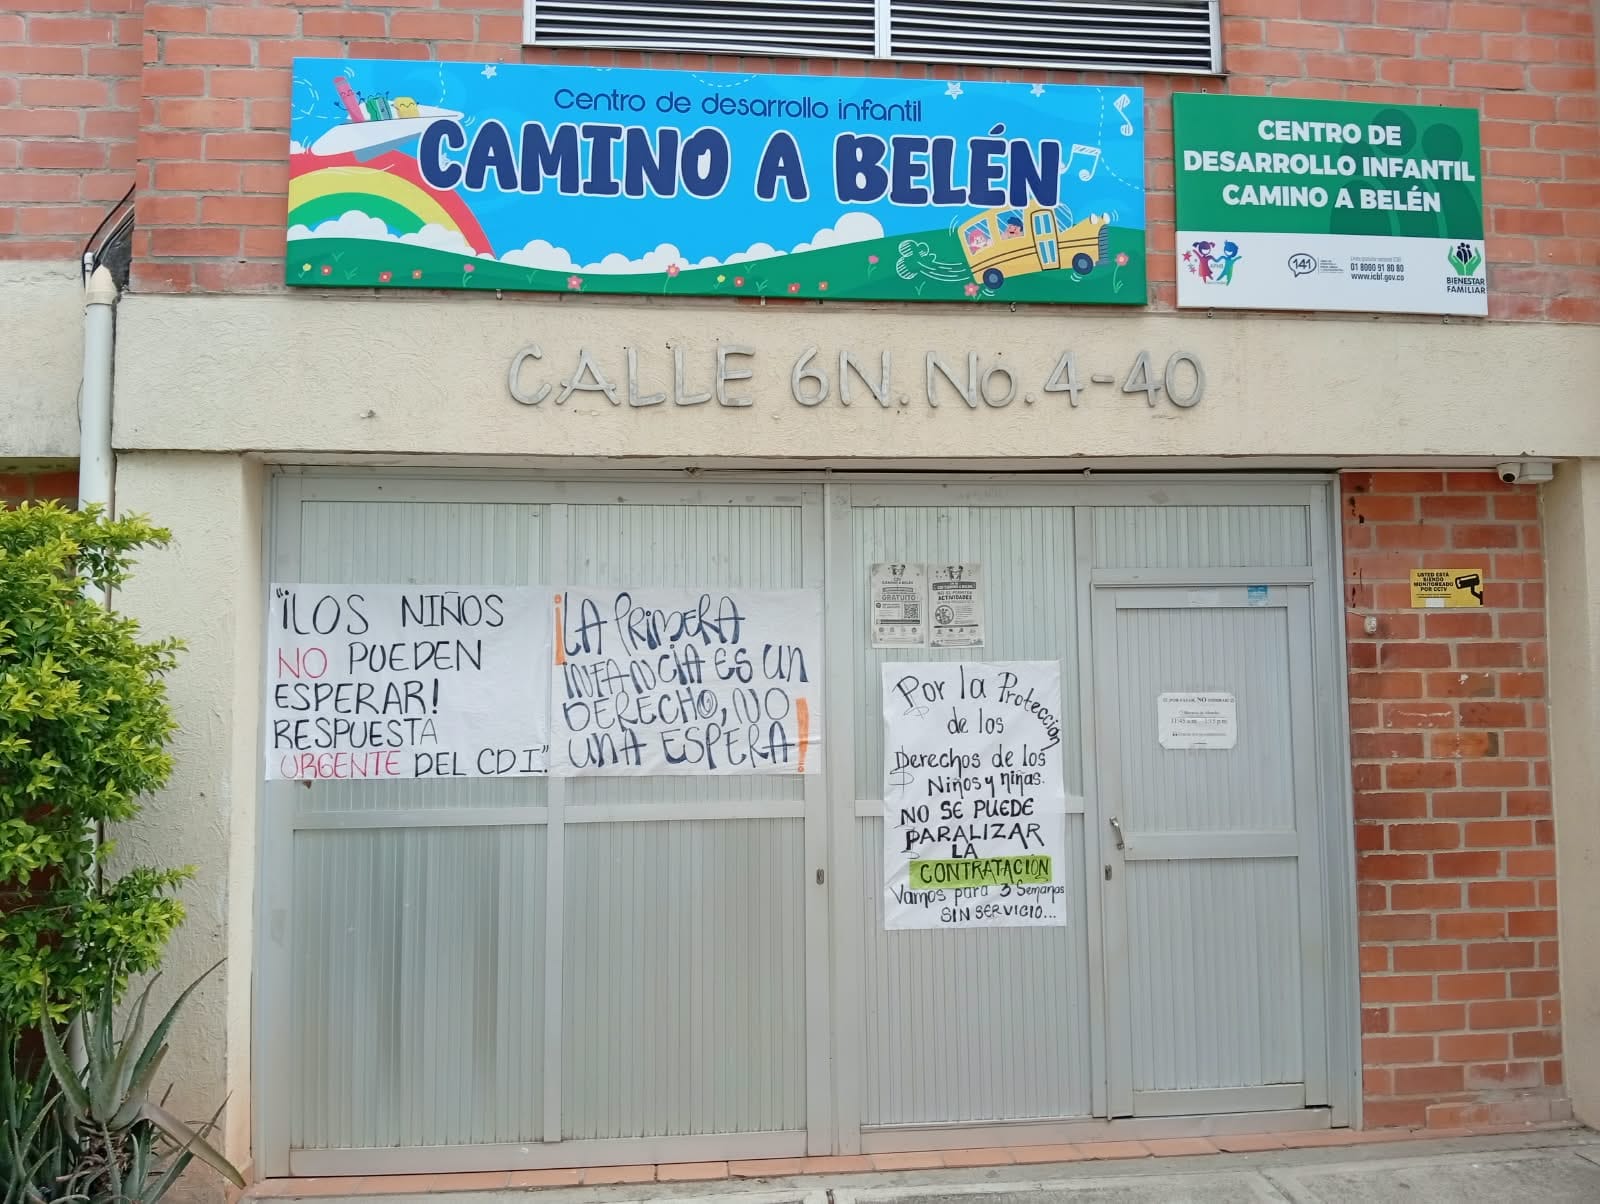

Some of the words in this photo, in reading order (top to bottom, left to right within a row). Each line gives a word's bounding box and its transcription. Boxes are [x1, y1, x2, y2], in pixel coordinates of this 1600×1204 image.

[554, 88, 645, 112] Centro
[656, 91, 692, 114] de
[702, 93, 829, 119] desarrollo
[838, 98, 922, 122] infantil
[1258, 120, 1362, 144] CENTRO
[1368, 125, 1402, 146] DE
[419, 119, 731, 198] CAMINO
[755, 130, 809, 201] A
[834, 123, 1061, 208] BELÉN
[1184, 150, 1356, 176] DESARROLLO
[1363, 156, 1476, 182] INFANTIL
[1222, 184, 1328, 207] CAMINO
[1334, 188, 1354, 209] A
[1360, 185, 1441, 212] BELÉN
[1293, 258, 1312, 270] 141
[1350, 262, 1358, 271] 01
[1386, 263, 1395, 273] 80
[1395, 263, 1405, 273] 80
[1446, 276, 1486, 285] BIENESTAR
[1446, 285, 1486, 294] FAMILIAR
[508, 344, 756, 408] CALLE
[1044, 350, 1205, 409] 4-40
[402, 591, 504, 628] NIÑOS
[278, 647, 328, 679] NO
[348, 640, 482, 675] PUEDEN
[714, 646, 754, 683] ES
[275, 678, 439, 714] ESPERAR!
[891, 675, 945, 712] Por
[960, 665, 987, 700] la
[562, 687, 727, 733] DERECHO,
[732, 687, 790, 725] NO
[947, 706, 969, 735] de
[979, 707, 1004, 735] los
[273, 717, 438, 750] RESPUESTA
[280, 750, 401, 778] URGENTE
[415, 751, 467, 777] DEL
[890, 746, 981, 779] Derechos
[992, 744, 1014, 768] de
[1022, 744, 1046, 767] los
[984, 775, 994, 798] y
[900, 804, 930, 826] NO
[940, 800, 963, 820] SE
[973, 798, 1034, 819] PUEDE
[905, 823, 1045, 851] PARALIZAR
[951, 843, 979, 859] LA
[889, 884, 946, 908] Vamos
[955, 884, 988, 907] para
[1000, 882, 1012, 898] 3
[1017, 879, 1065, 904] Semanas
[940, 906, 970, 923] SIN
[975, 904, 1056, 920] SERVICIO...
